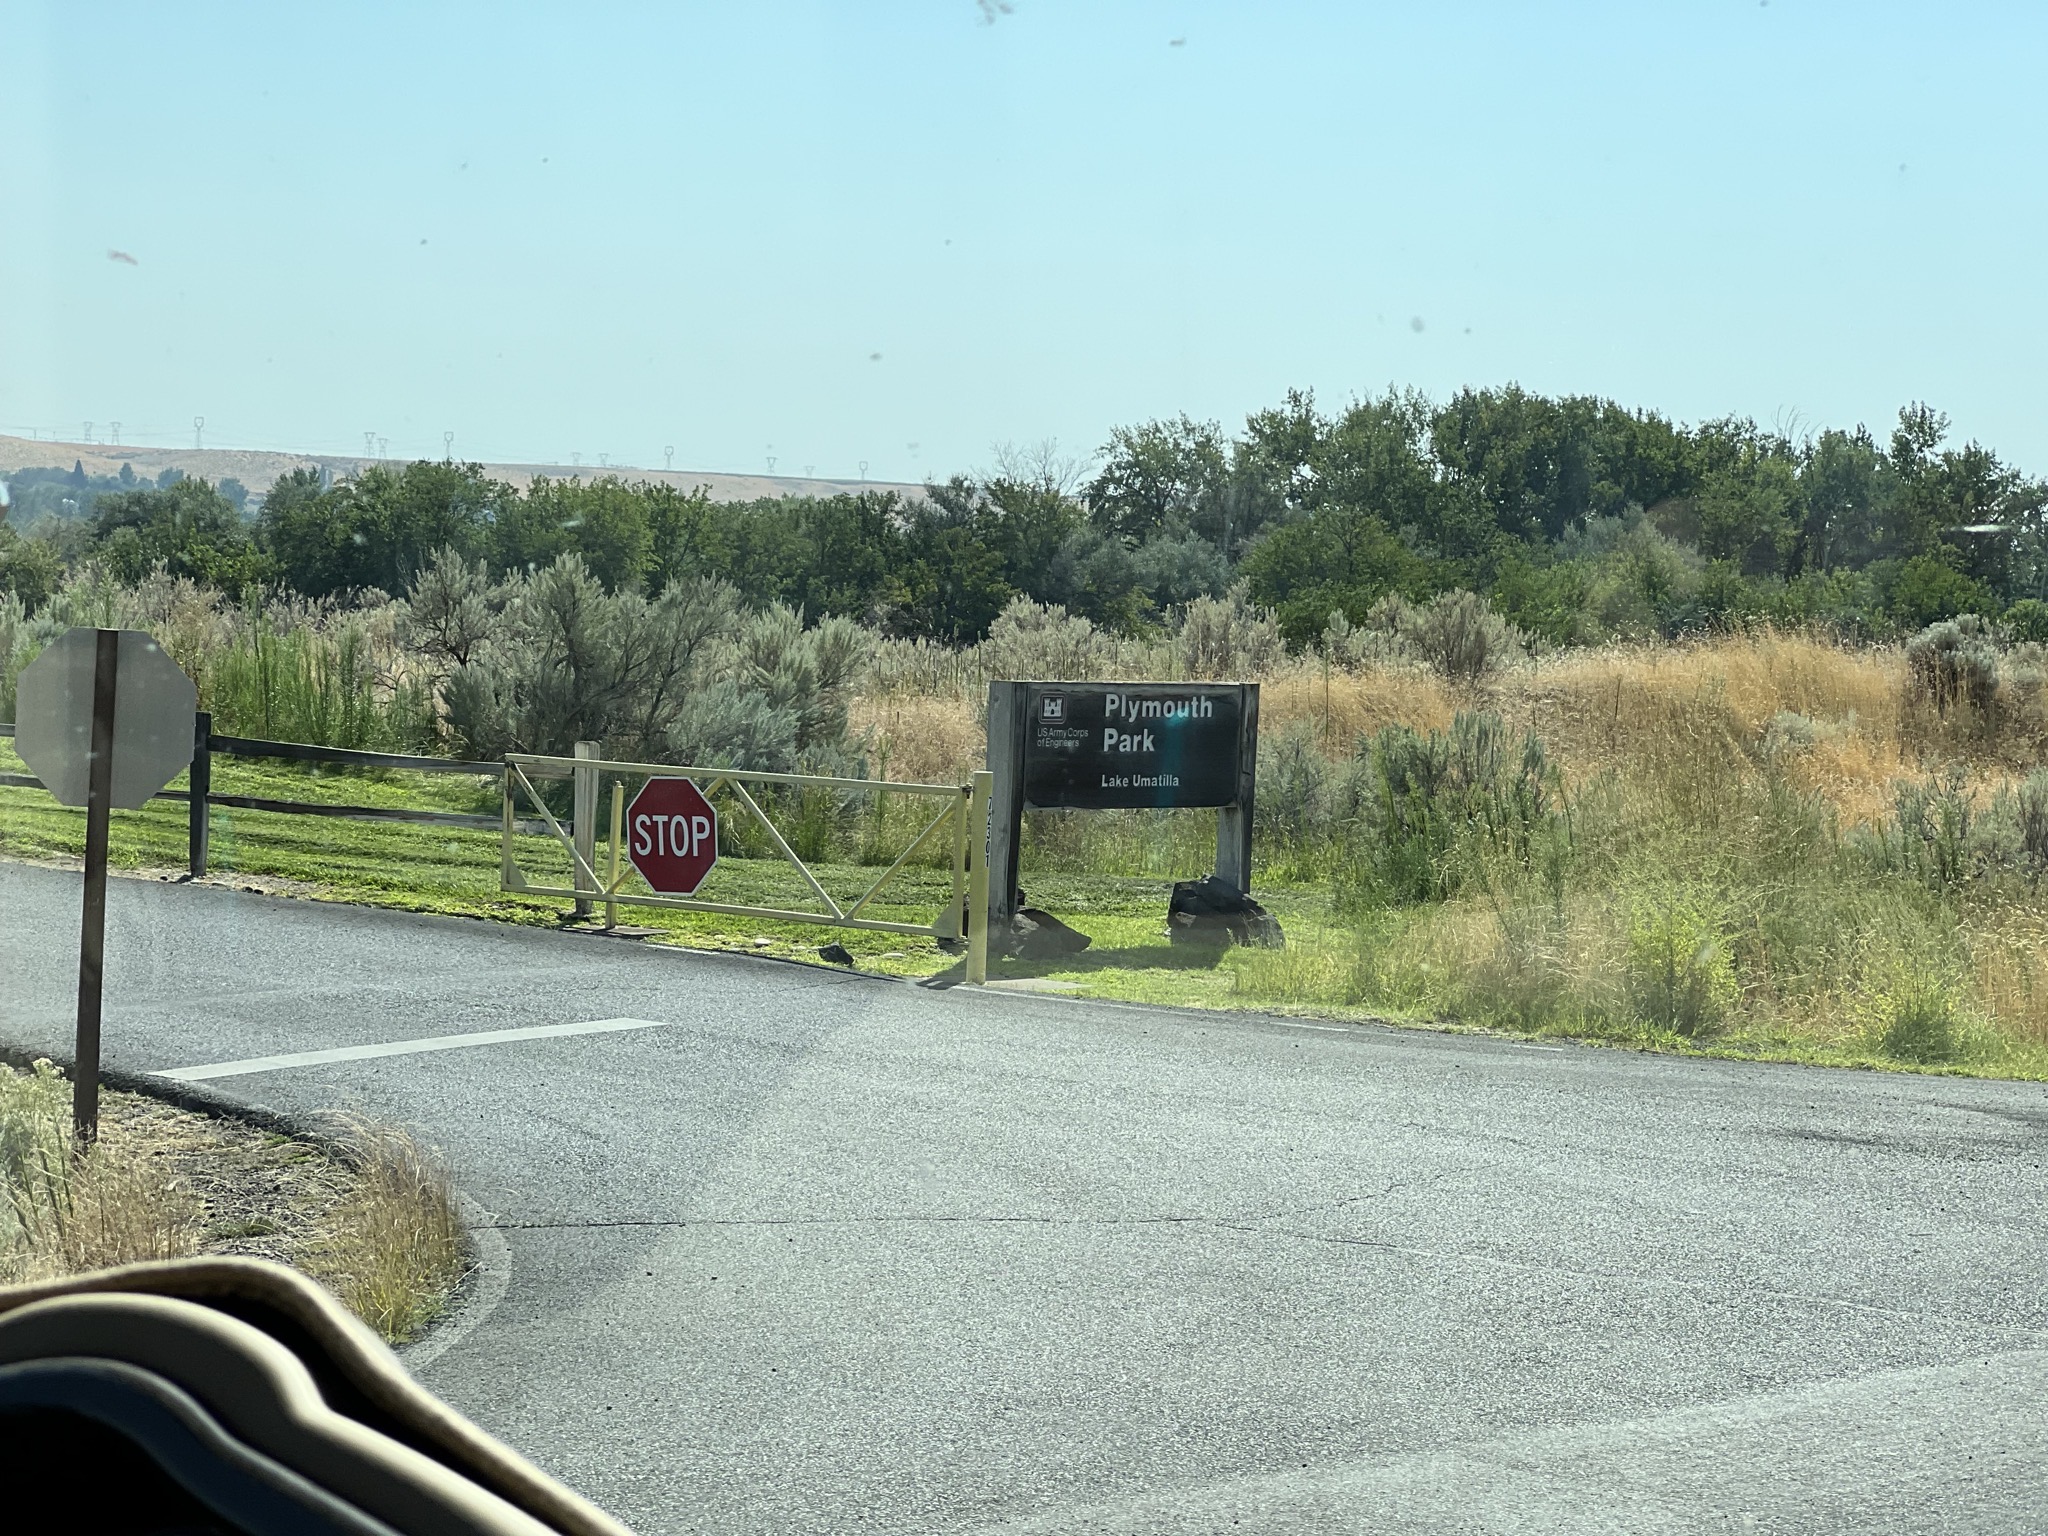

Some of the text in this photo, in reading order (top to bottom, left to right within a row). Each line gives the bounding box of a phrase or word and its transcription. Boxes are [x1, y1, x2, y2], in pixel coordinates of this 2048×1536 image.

[1104, 693, 1213, 723] Plymouth
[1037, 727, 1089, 739] US Army Corps
[1103, 727, 1155, 752] Park
[1037, 737, 1080, 749] of Engineers
[1101, 774, 1180, 788] Lake Umatilla
[634, 813, 711, 858] STOP
